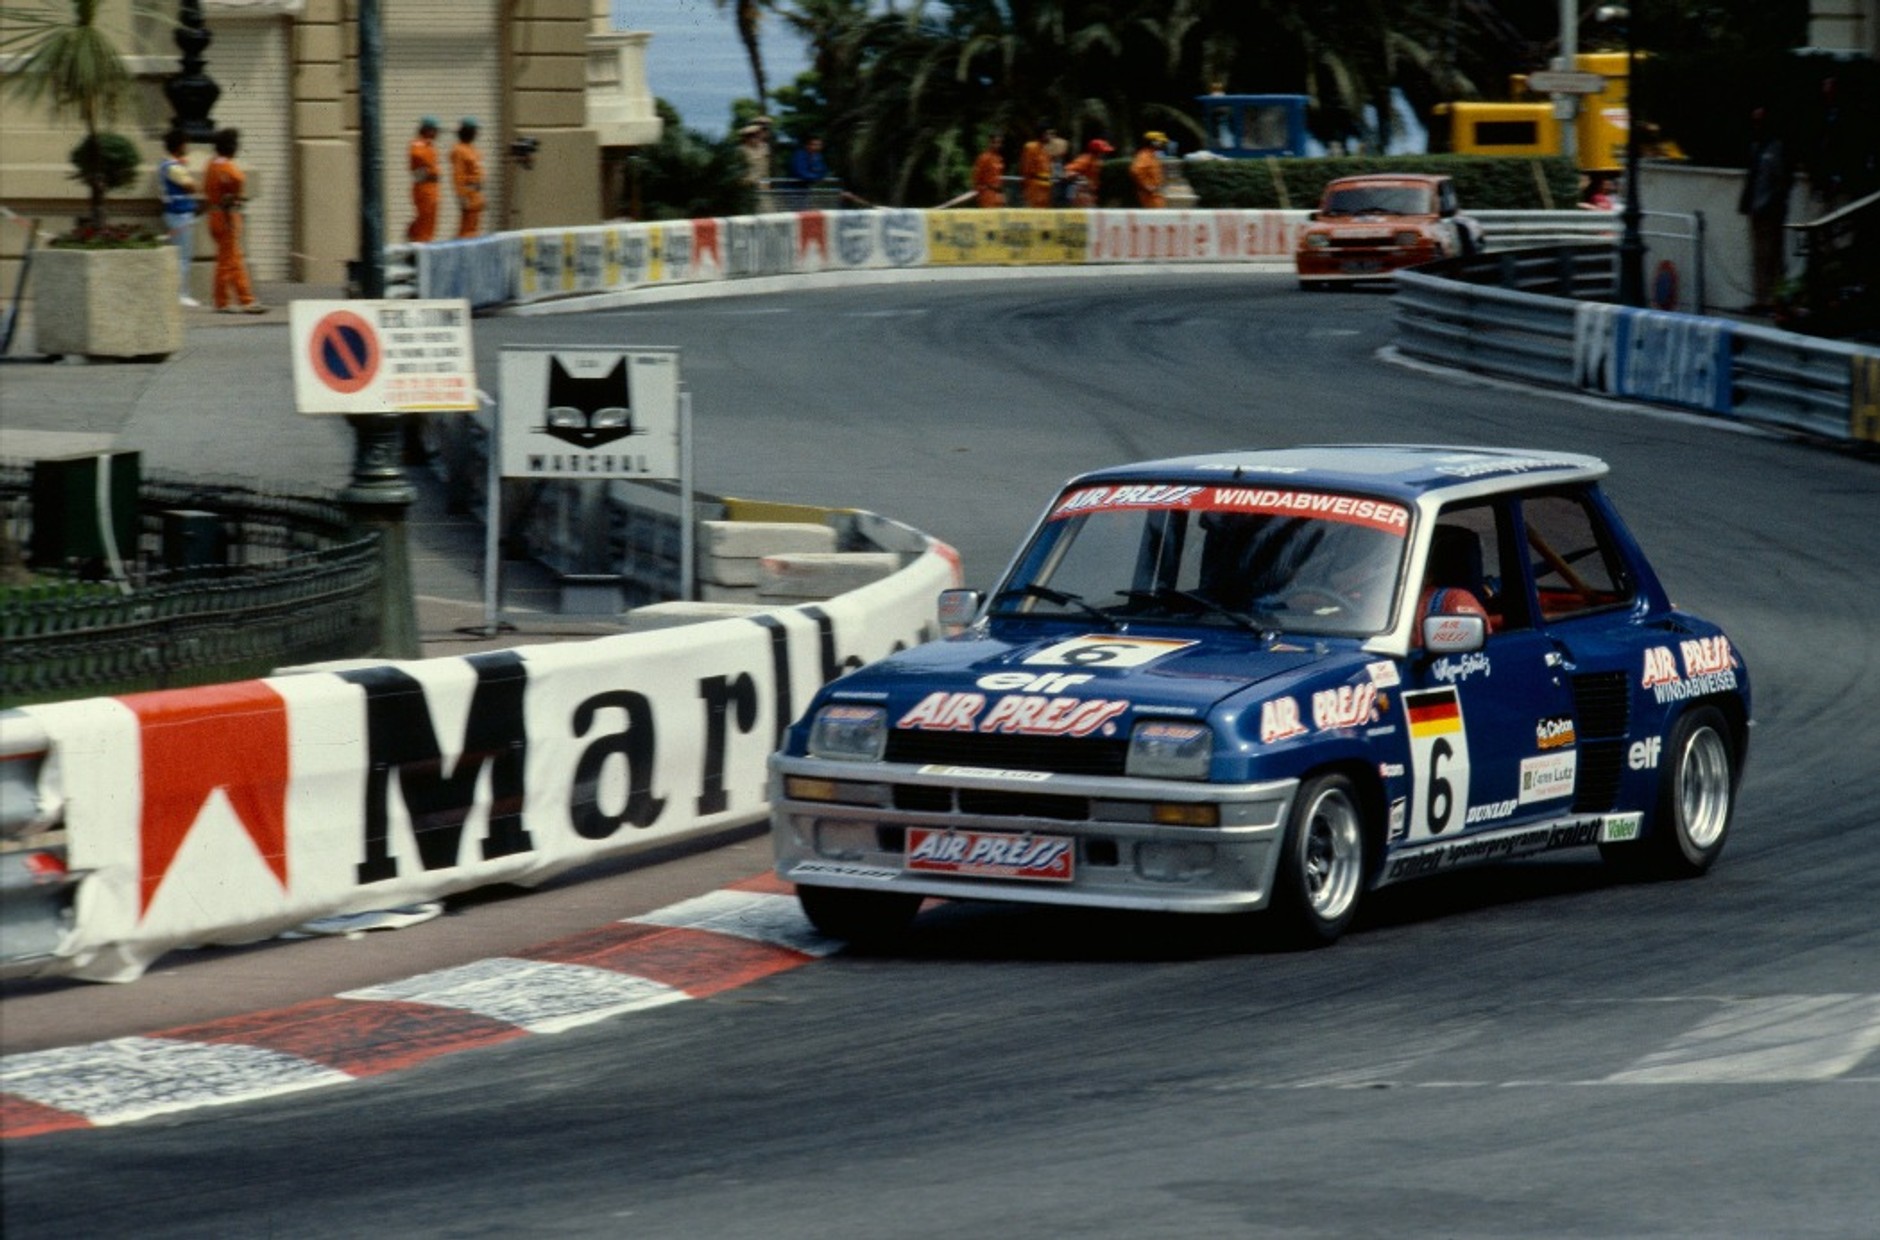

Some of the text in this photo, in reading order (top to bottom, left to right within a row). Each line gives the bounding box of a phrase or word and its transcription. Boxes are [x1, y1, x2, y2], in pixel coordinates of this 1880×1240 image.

[1093, 212, 1208, 258] Johnnie
[1215, 212, 1303, 256] Walk
[527, 455, 650, 473] MARCHAL
[1054, 484, 1408, 528] AIR PRESS WINDABWEISER
[1060, 643, 1131, 667] 6
[1642, 635, 1733, 690] AIR PRESS
[975, 672, 1096, 694] elf
[1653, 670, 1738, 704] WINDABWEISER
[897, 691, 1130, 738] AIR PRESS
[1260, 681, 1377, 743] AIR PRESS
[334, 606, 936, 886] Marl
[1628, 736, 1662, 771] elf
[1427, 736, 1453, 835] 6
[1466, 799, 1519, 823] DUNLOP
[1607, 819, 1637, 839] Valeo
[912, 831, 1068, 870] AIR PRESS
